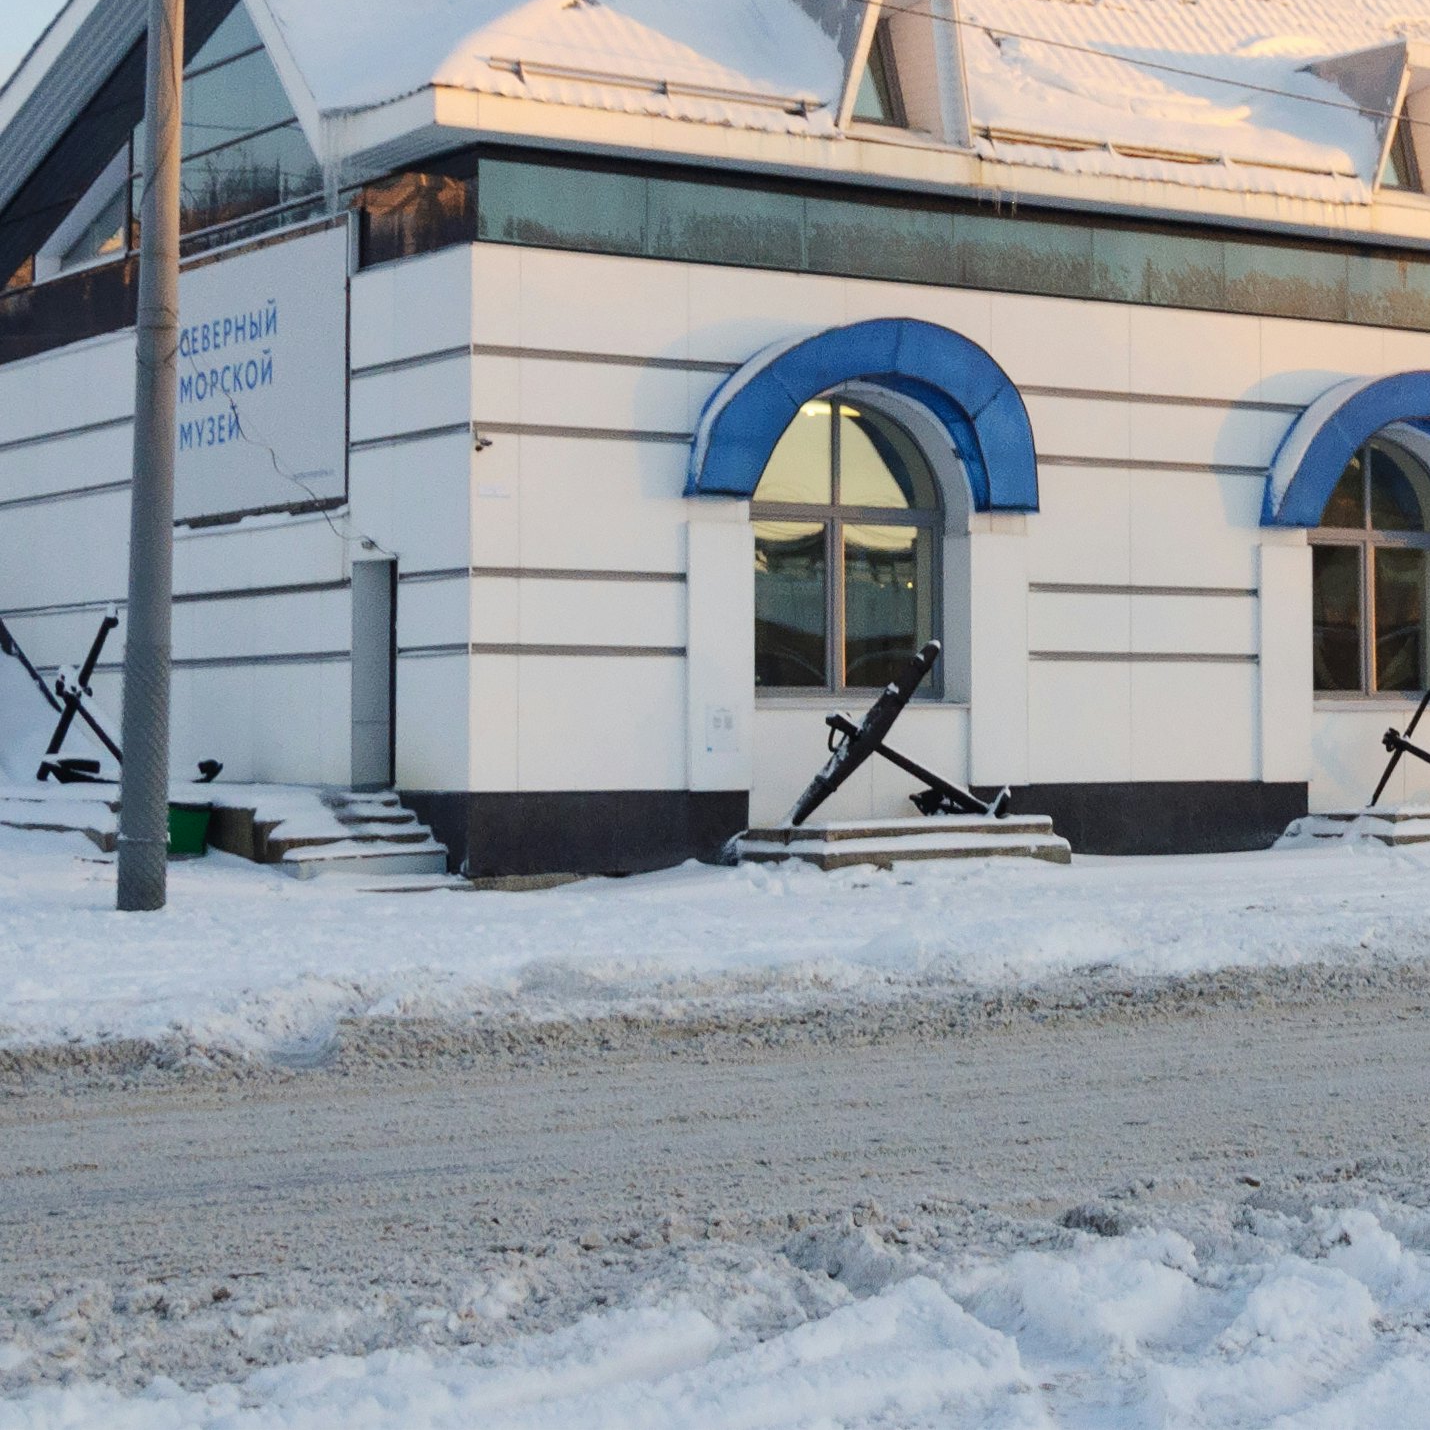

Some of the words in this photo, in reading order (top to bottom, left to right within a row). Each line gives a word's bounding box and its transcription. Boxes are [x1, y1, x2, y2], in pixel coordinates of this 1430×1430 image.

[179, 298, 278, 357] СЕВЕРНЫЙ
[179, 349, 274, 403] МОРСКОЙ
[179, 403, 242, 450] МУЗЕЙ
